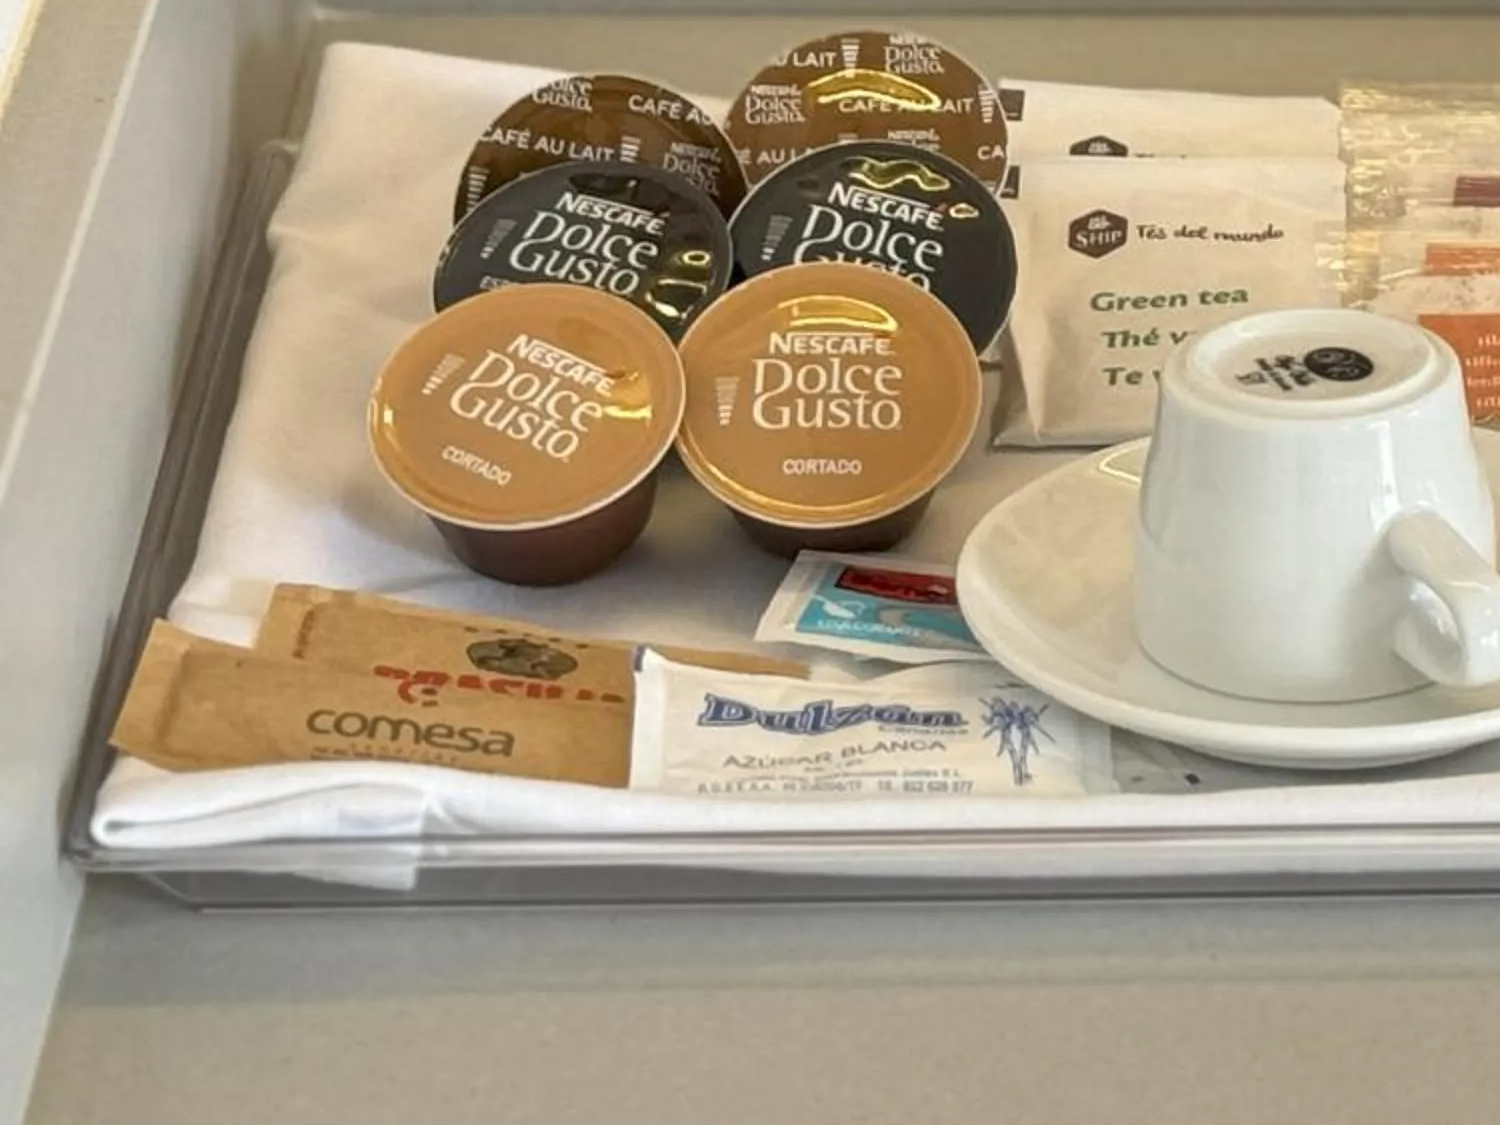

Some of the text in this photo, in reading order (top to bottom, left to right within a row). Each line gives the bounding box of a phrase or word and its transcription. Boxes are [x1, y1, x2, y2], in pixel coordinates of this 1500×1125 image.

[793, 52, 836, 68] LAIT
[628, 93, 681, 120] CAFÉ
[534, 135, 565, 156] AU
[568, 143, 615, 162] LAIT
[756, 150, 786, 164] AU
[521, 210, 659, 270] Dolce
[801, 203, 943, 272] Dolce
[1173, 225, 1208, 239] del
[1213, 224, 1284, 242] mundo
[508, 237, 640, 299] Gusto
[1090, 288, 1249, 312] Green tea
[1100, 326, 1160, 349] Thé
[468, 348, 603, 433] Dolce
[752, 357, 902, 396] Dolce
[450, 380, 579, 461] Gusto
[752, 390, 902, 430] Gusto
[441, 445, 512, 486] CORTADO
[782, 459, 862, 475] CORTADO
[305, 709, 515, 758] comesa
[841, 737, 947, 759] BLANCA
